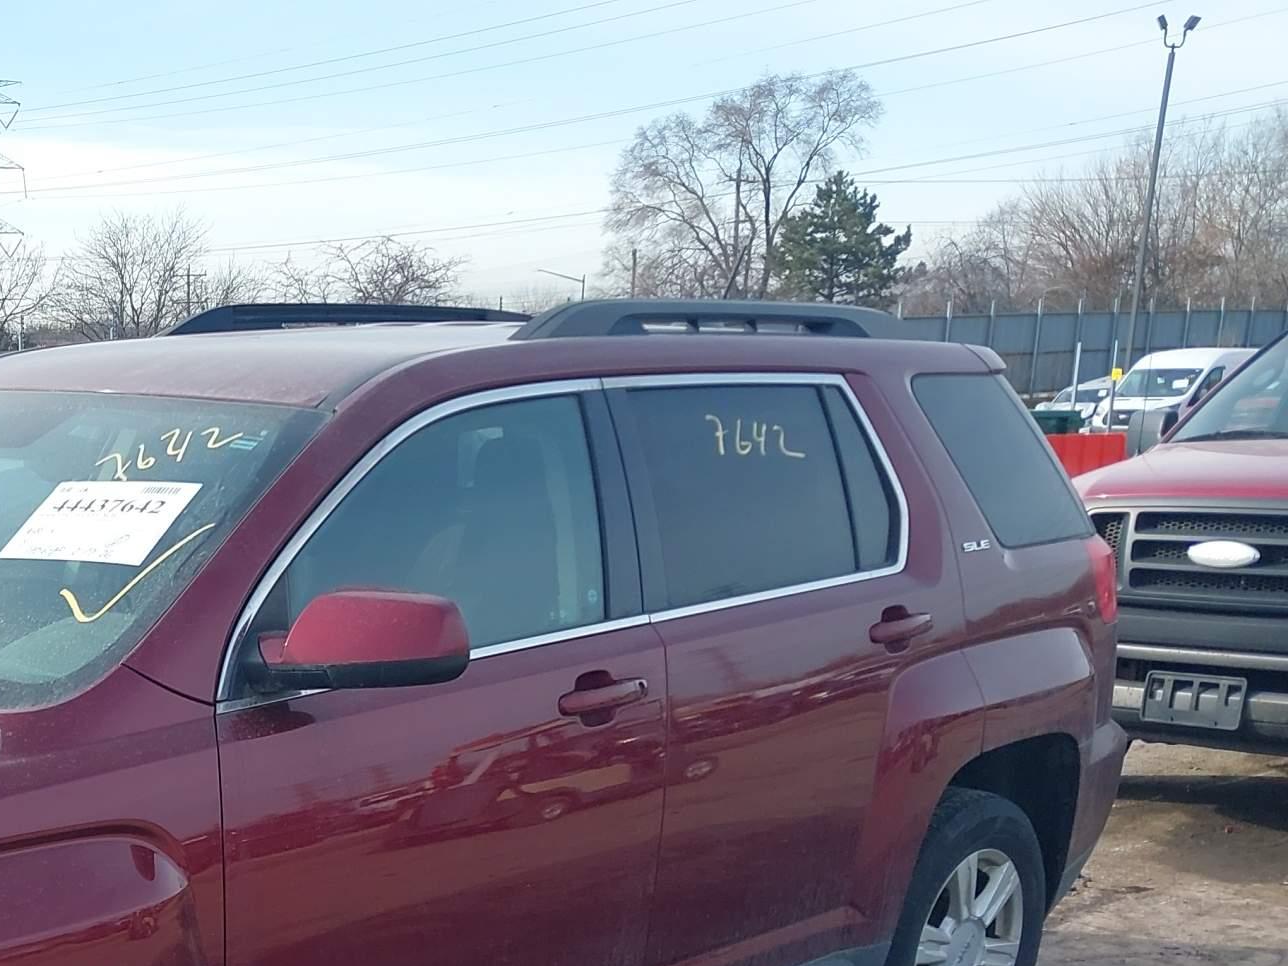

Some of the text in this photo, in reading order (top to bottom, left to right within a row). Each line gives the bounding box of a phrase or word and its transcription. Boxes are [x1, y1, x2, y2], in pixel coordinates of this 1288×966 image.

[705, 414, 806, 458] 7642
[95, 427, 243, 481] 7642
[52, 499, 166, 515] 44437642
[962, 539, 991, 552] SLE
